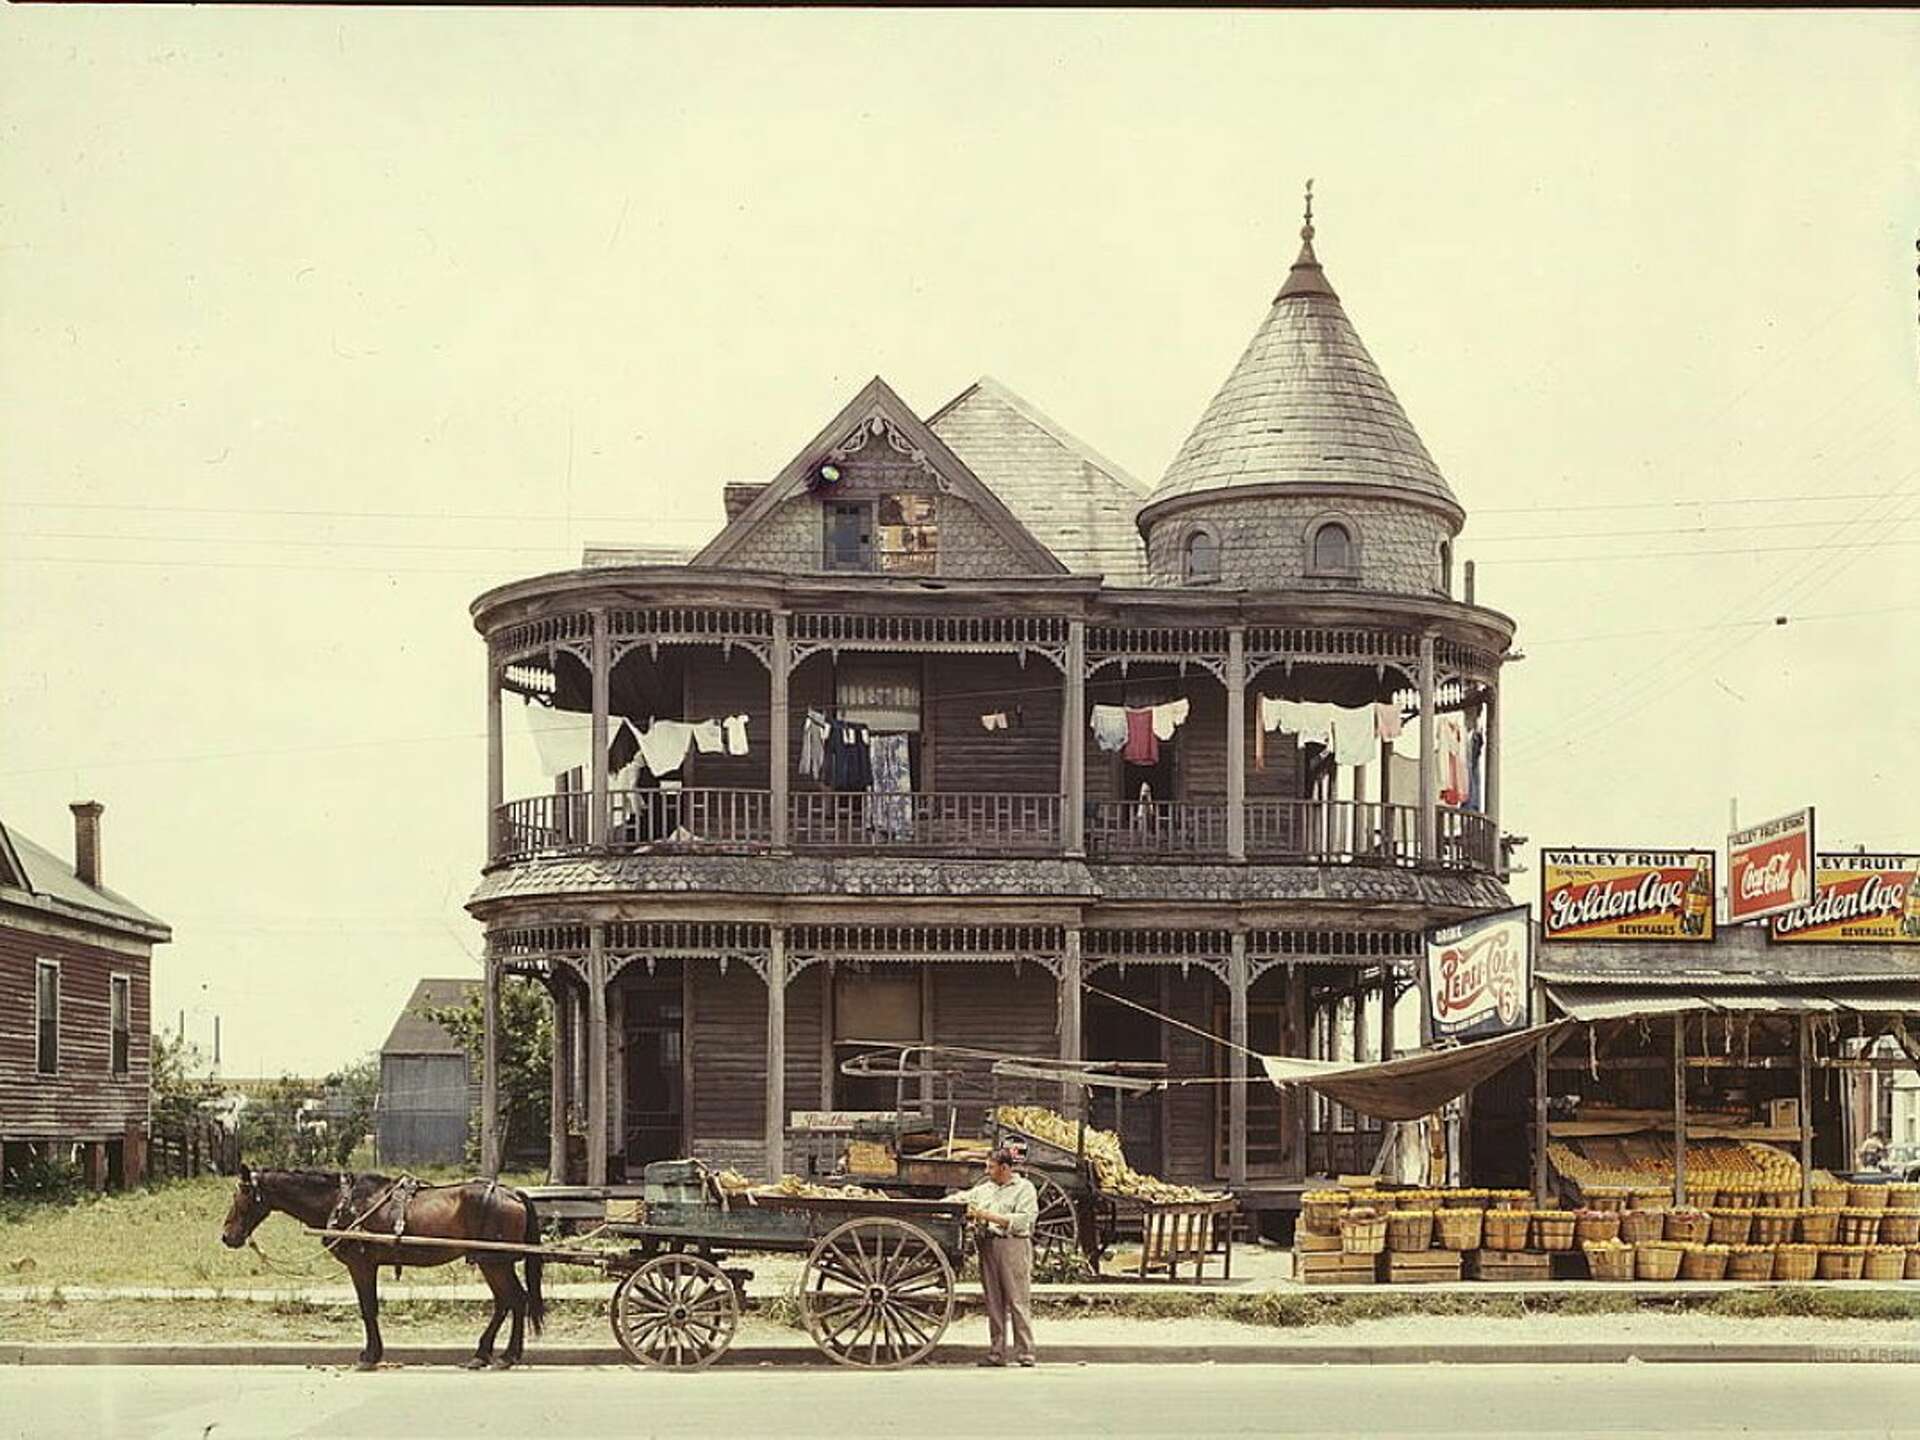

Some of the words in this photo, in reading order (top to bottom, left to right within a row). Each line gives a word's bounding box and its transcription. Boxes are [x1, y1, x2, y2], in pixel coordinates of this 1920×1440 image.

[1550, 854, 1619, 866] VALLEY
[1626, 854, 1687, 866] FRUIT
[1849, 858, 1906, 870] FRUIT
[1550, 882, 1637, 930] Golden
[1638, 871, 1684, 914] Age
[1860, 874, 1904, 918] Age
[1617, 924, 1676, 936] BEVERAGES
[1840, 927, 1897, 937] BEVERAGES
